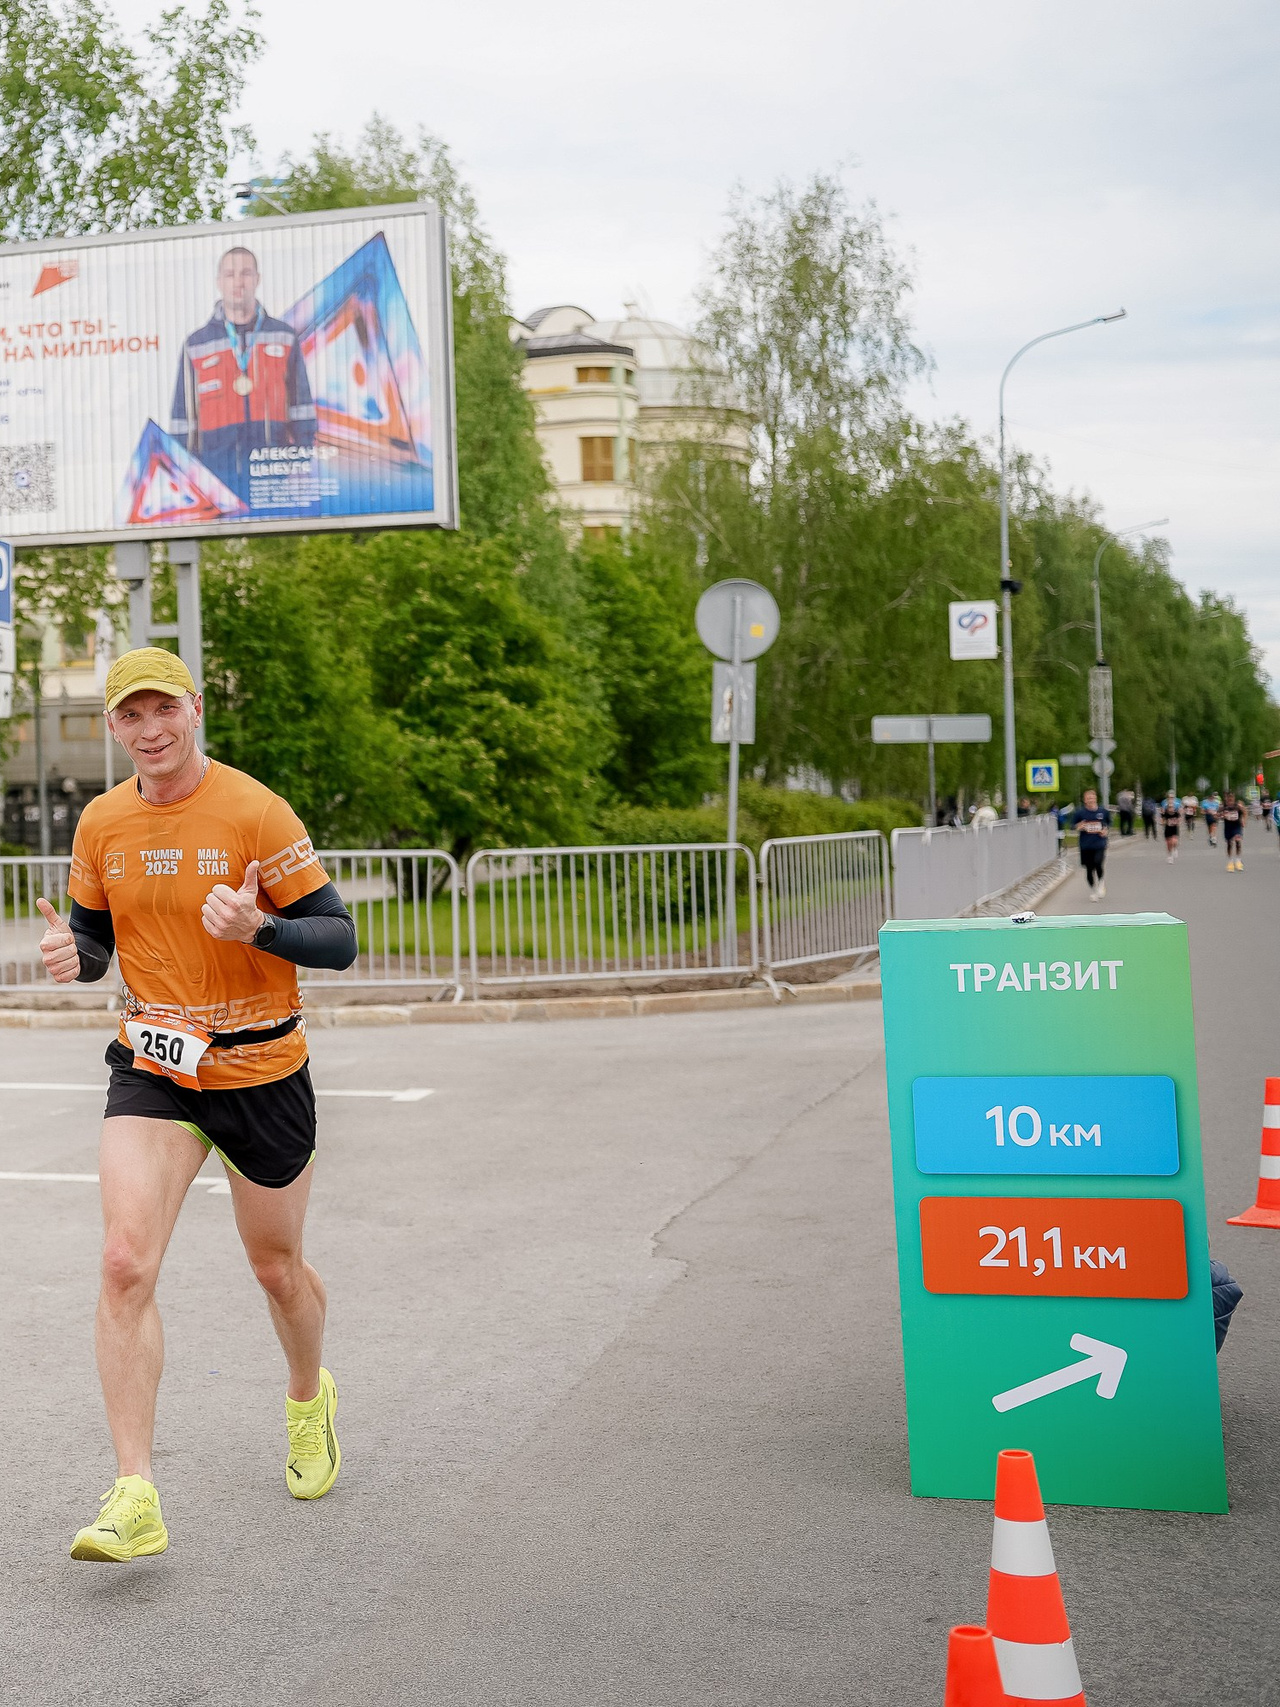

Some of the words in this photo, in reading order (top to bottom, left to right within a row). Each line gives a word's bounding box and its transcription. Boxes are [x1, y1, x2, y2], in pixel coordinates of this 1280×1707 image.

[20, 322, 63, 339] ЧТО
[70, 319, 103, 335] ТЫ
[5, 345, 35, 362] НА
[42, 335, 160, 360] МИЛЛИОН
[140, 848, 183, 861] TYUMEN
[197, 848, 219, 860] MAN
[145, 860, 178, 875] 2025
[197, 860, 230, 875] STAR
[949, 960, 1124, 992] ТРАНЗИТ
[140, 1030, 185, 1066] 250
[985, 1105, 1043, 1147] 10
[1049, 1124, 1102, 1147] км
[978, 1226, 1063, 1277] 21,1
[1073, 1246, 1127, 1269] км
